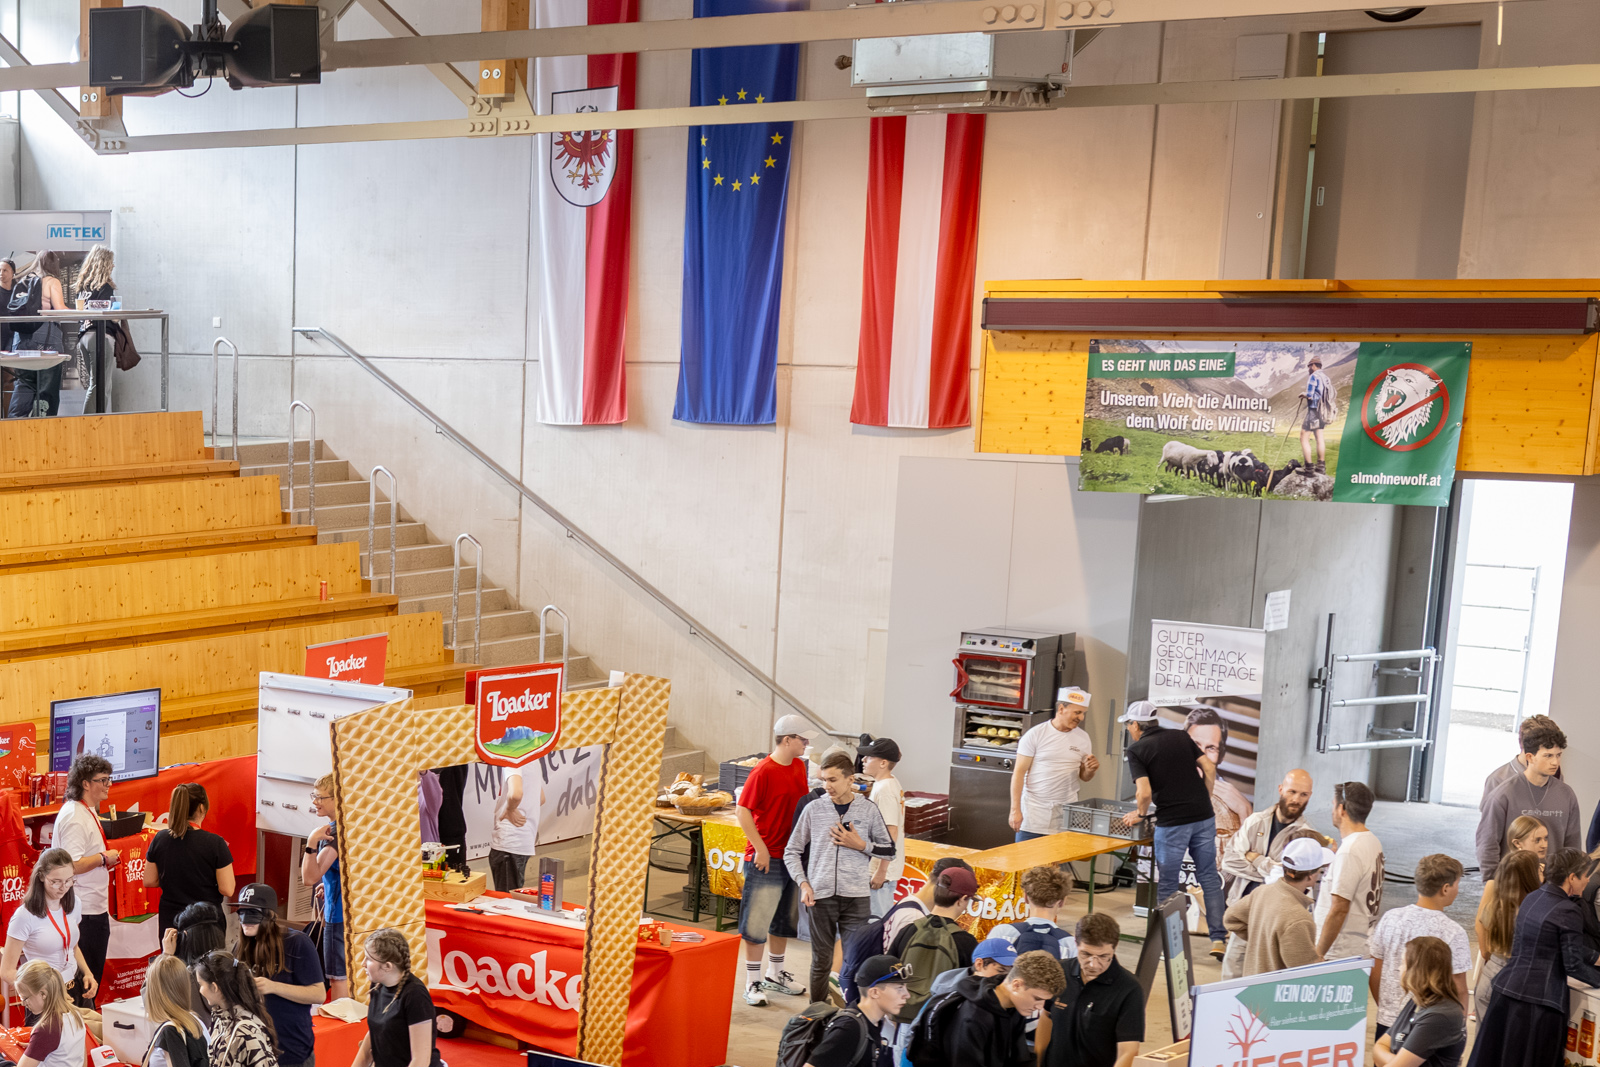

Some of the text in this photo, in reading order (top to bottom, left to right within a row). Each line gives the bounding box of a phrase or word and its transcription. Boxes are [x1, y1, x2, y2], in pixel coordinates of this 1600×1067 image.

[50, 226, 103, 238] METEK
[1101, 358, 1227, 371] ES GEHT NUR DAS EINE:
[1101, 391, 1272, 412] Unserem Vieh die Almen,
[1126, 413, 1276, 433] dem Wolf die Wildnis!
[1350, 471, 1442, 487] almohnewolf.at
[1157, 629, 1204, 646] GUTER
[1156, 644, 1247, 665] GESCHMACK
[326, 654, 367, 678] Loacker
[1155, 658, 1257, 681] IST EINE FRAGE
[1155, 672, 1224, 692] DER ÄHRE
[486, 688, 551, 722] Loacker
[426, 927, 583, 1013] Loacke
[1274, 984, 1354, 1003] KEIN 08/15 JOB
